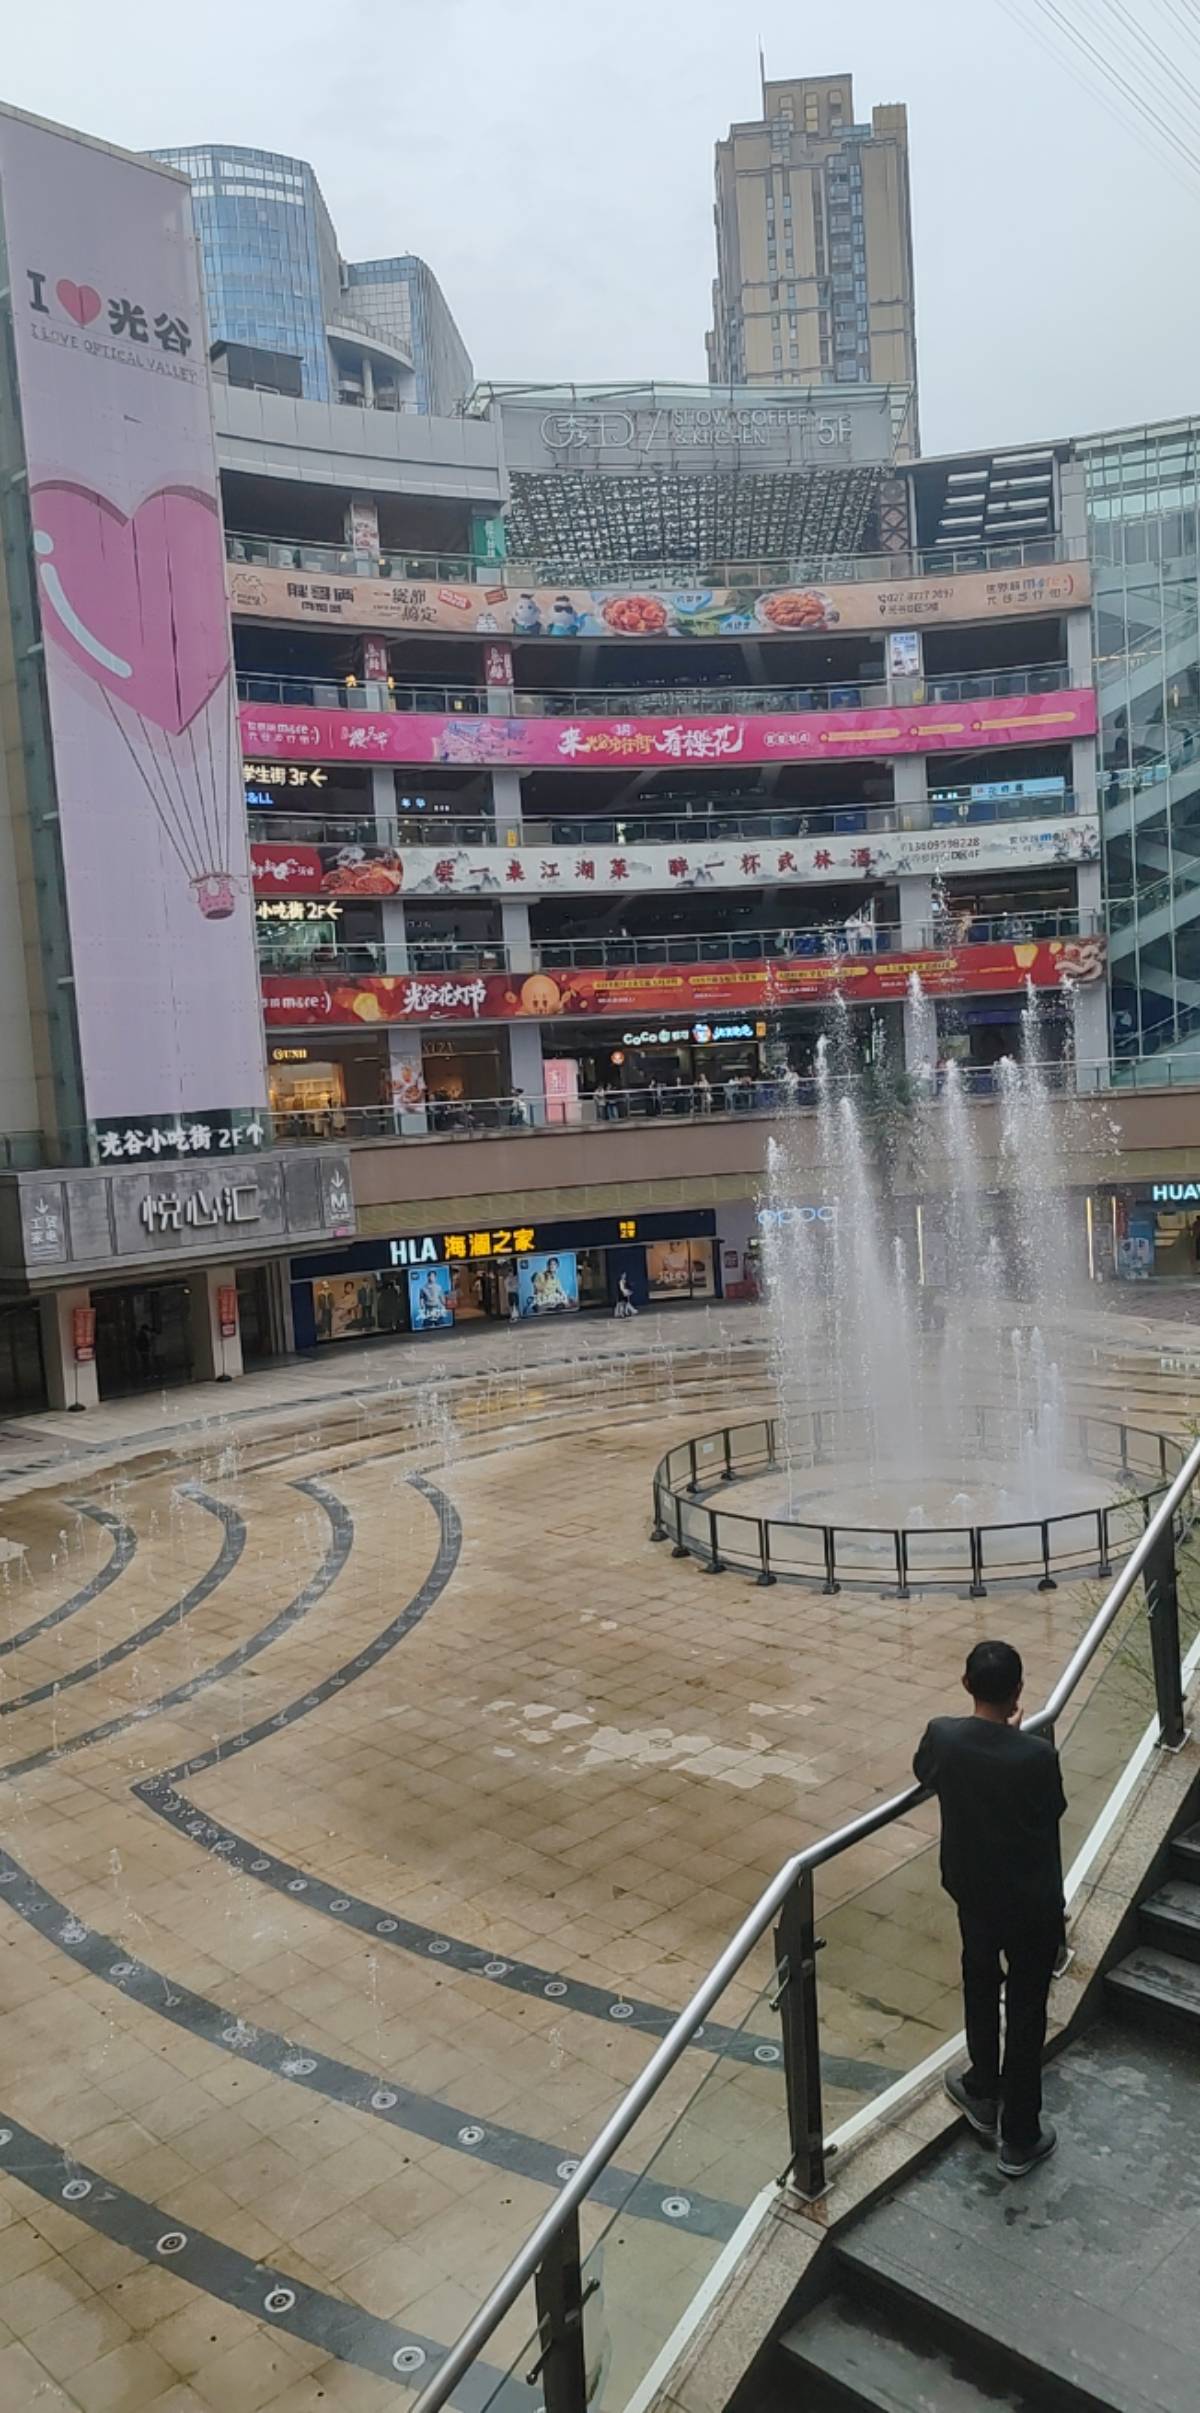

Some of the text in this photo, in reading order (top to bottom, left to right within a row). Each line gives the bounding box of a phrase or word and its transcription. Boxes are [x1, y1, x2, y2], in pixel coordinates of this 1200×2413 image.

[27, 269, 192, 357] I 光谷
[42, 326, 78, 349] LOVE
[83, 339, 145, 368] OPTICAL
[146, 358, 198, 386] VALLEY
[673, 409, 807, 426] SHOW COFFEE
[818, 416, 852, 445] 5F
[692, 430, 767, 446] KITCHEN
[288, 768, 308, 786] 3F
[307, 902, 326, 919] 2F
[101, 1124, 243, 1157] 光谷小吃街 2F
[142, 1184, 262, 1233] 悦心汇
[389, 1228, 536, 1266] HLA 海澜之家
